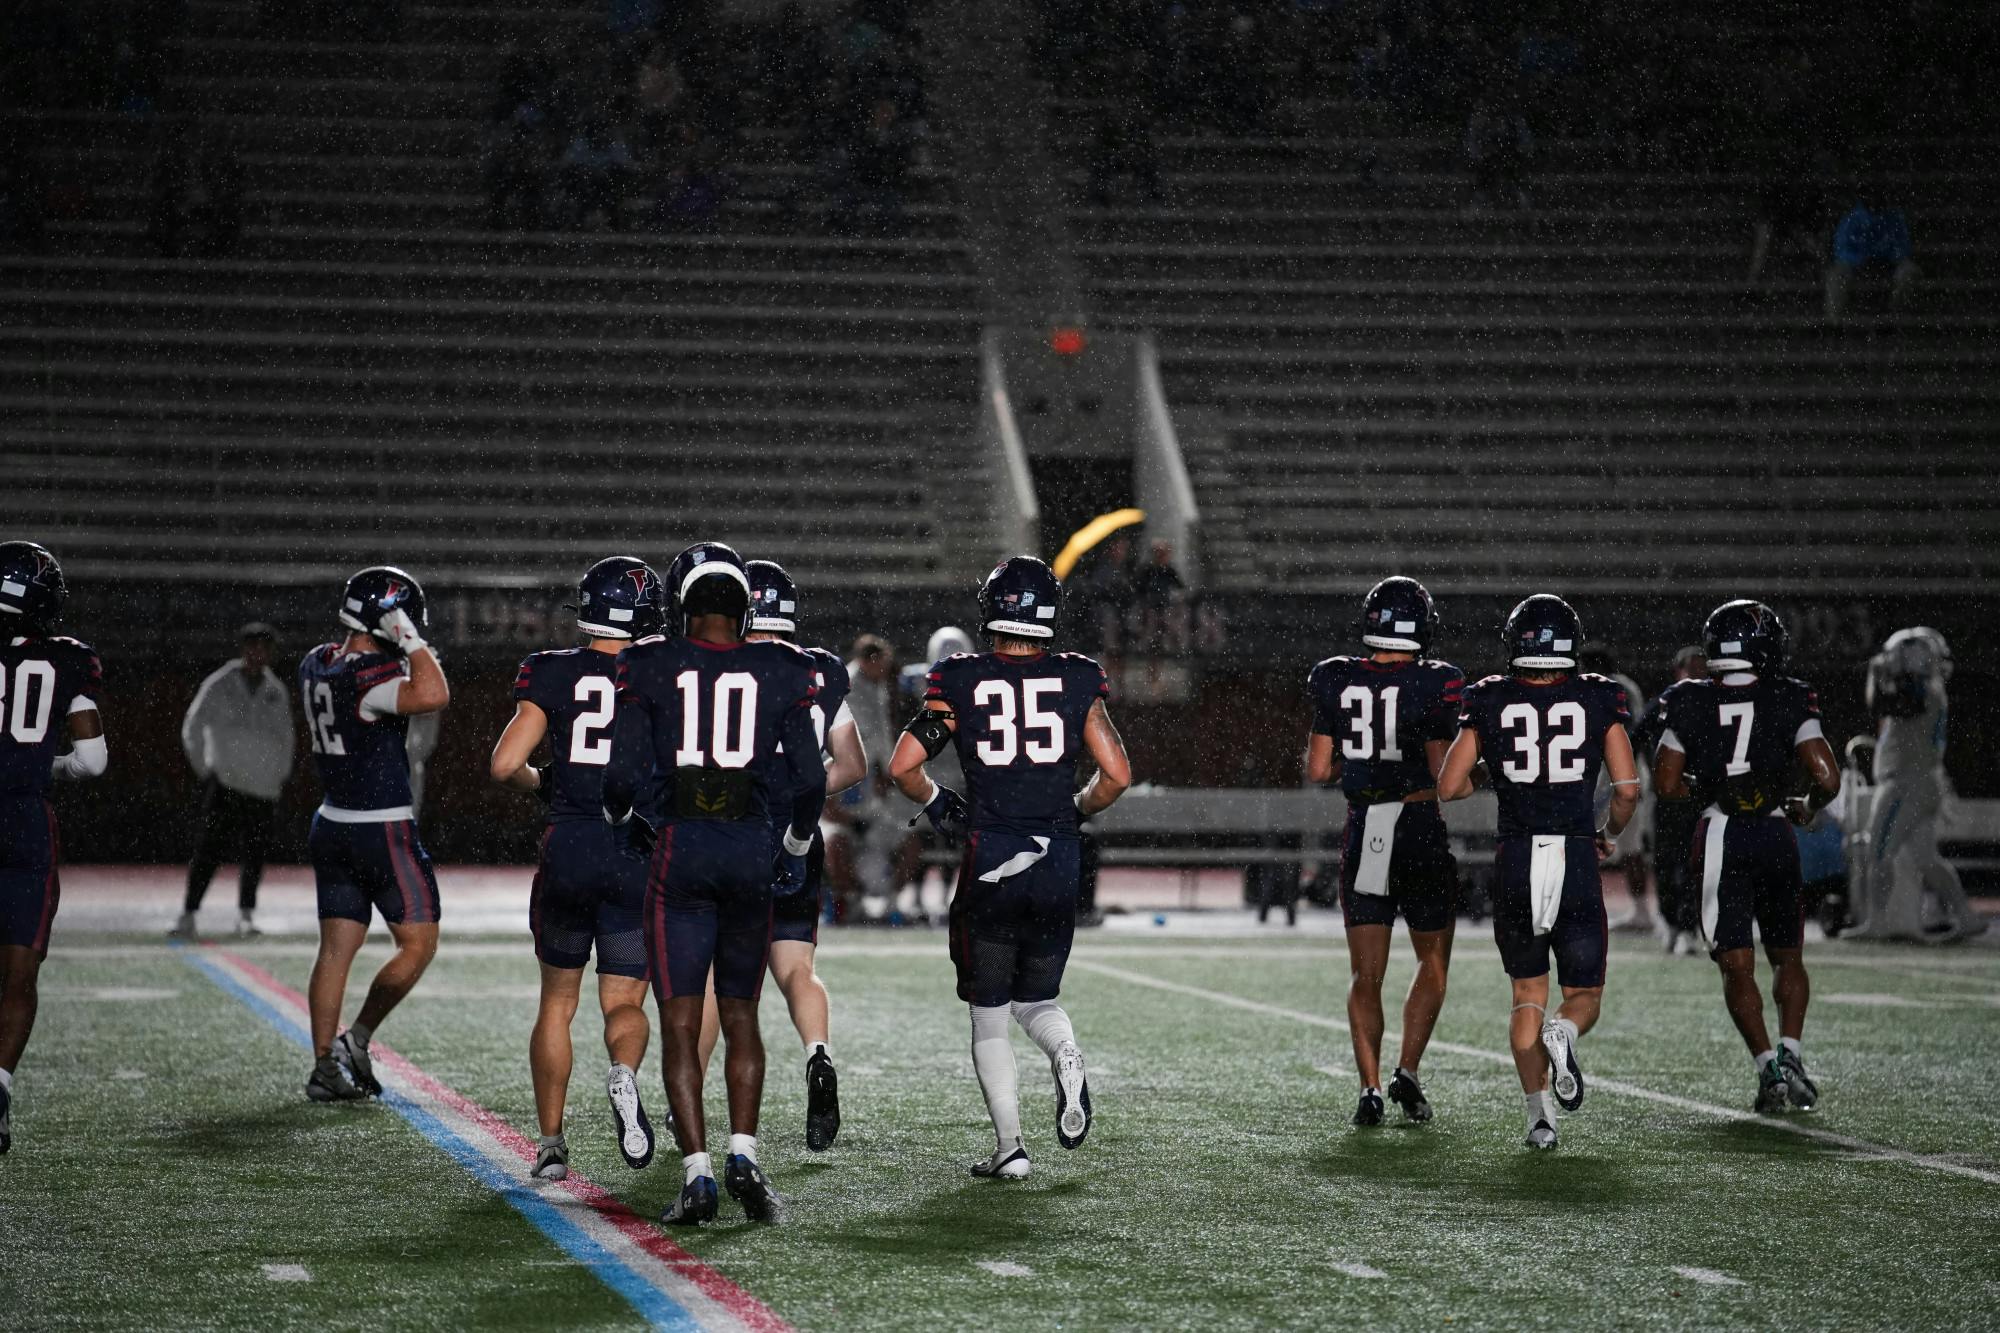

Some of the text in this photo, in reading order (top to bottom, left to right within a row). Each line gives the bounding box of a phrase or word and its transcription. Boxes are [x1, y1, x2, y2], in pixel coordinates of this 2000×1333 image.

[304, 678, 346, 756] 12
[569, 675, 616, 765] 2
[676, 670, 759, 768] 10
[973, 677, 1065, 766] 35
[1340, 685, 1403, 761] 31
[1500, 701, 1587, 784] 32
[1718, 700, 1756, 777] 7
